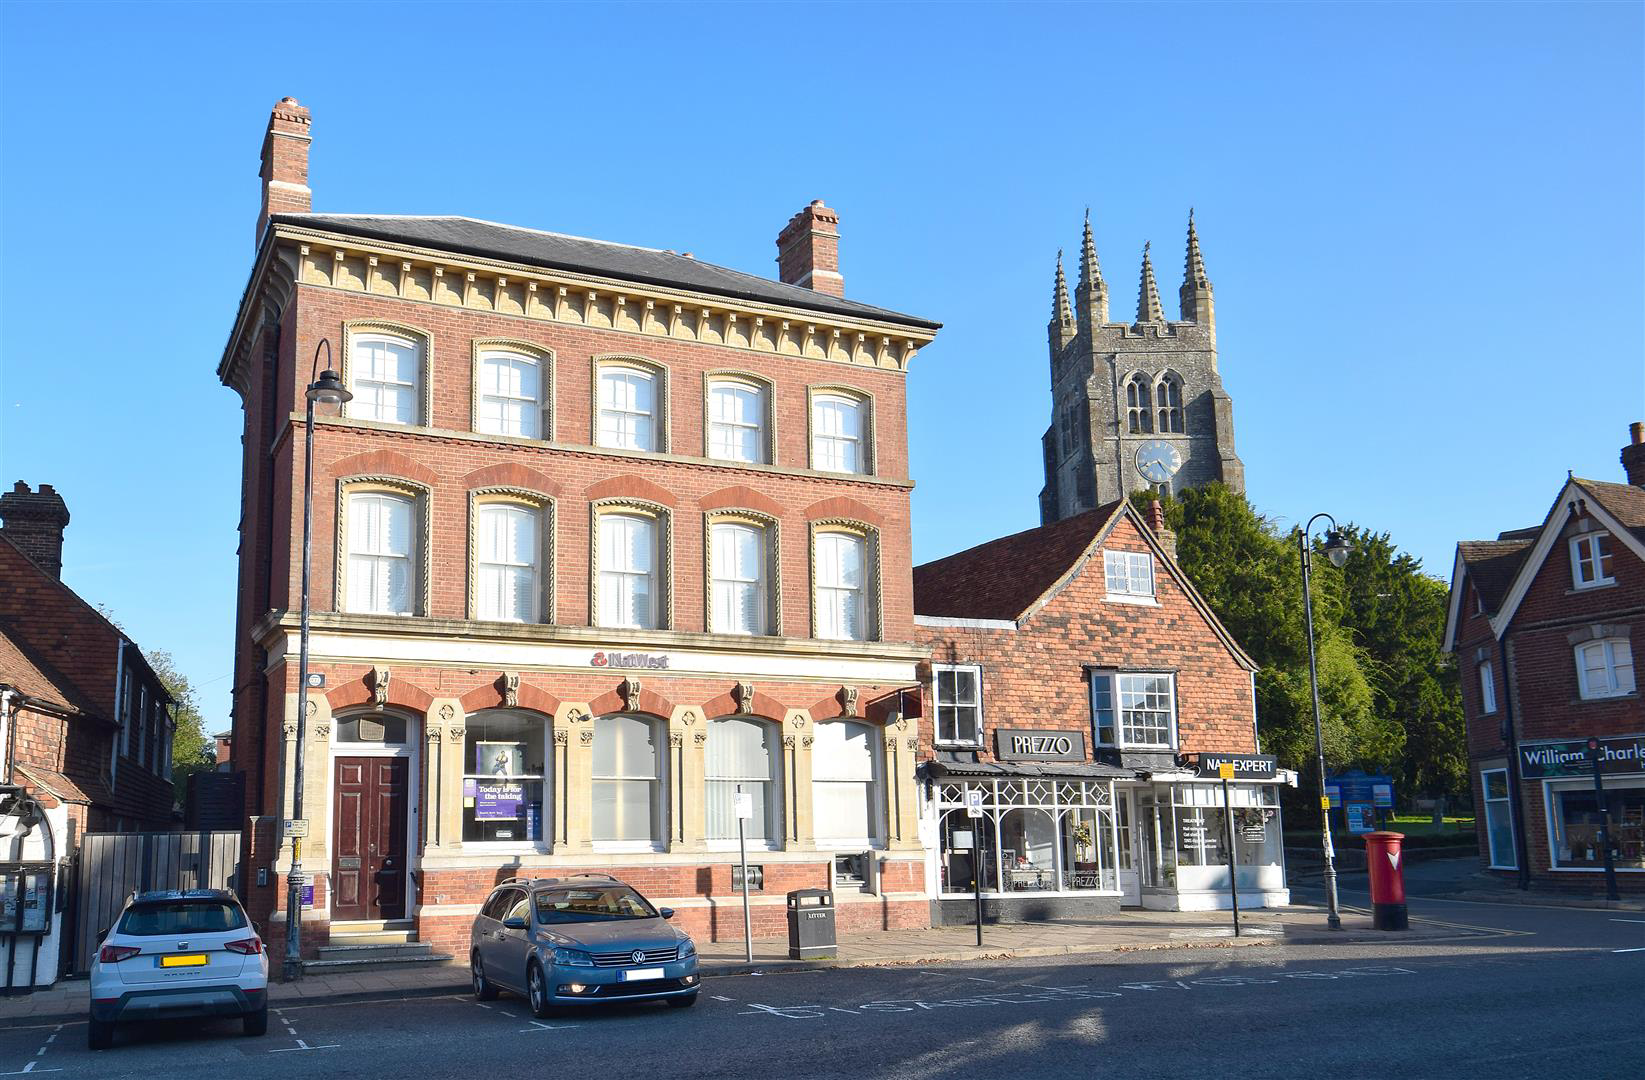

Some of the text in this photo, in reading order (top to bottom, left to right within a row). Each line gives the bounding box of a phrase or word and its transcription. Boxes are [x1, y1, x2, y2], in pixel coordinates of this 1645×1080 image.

[608, 652, 669, 668] NatWest
[1013, 735, 1072, 754] PREZZO
[1524, 749, 1585, 765] William
[1233, 759, 1273, 772] EXPERT
[479, 786, 501, 794] Today
[1072, 876, 1101, 889] PREZZO
